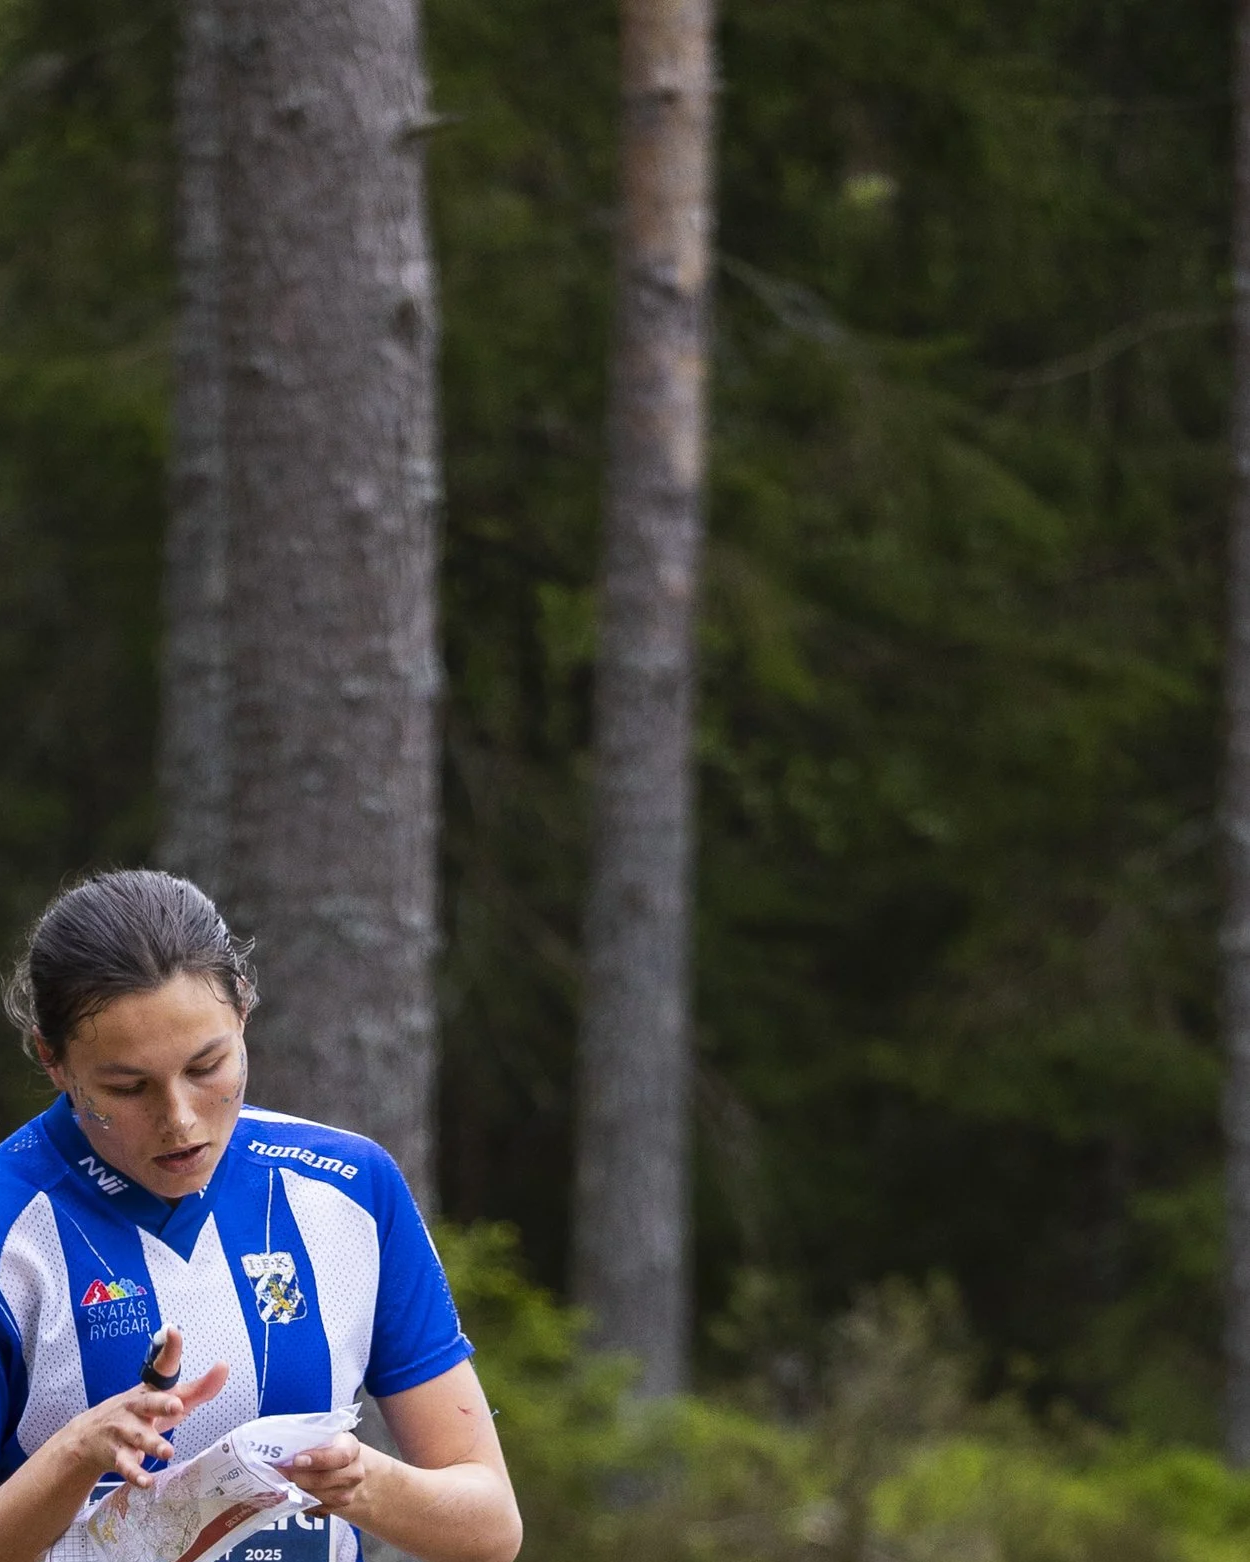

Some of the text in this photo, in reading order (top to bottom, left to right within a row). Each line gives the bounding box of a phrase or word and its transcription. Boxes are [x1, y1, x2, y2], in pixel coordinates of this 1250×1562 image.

[248, 1140, 358, 1179] noname
[90, 1317, 150, 1340] RYGGAR
[245, 1549, 282, 1561] 2025
